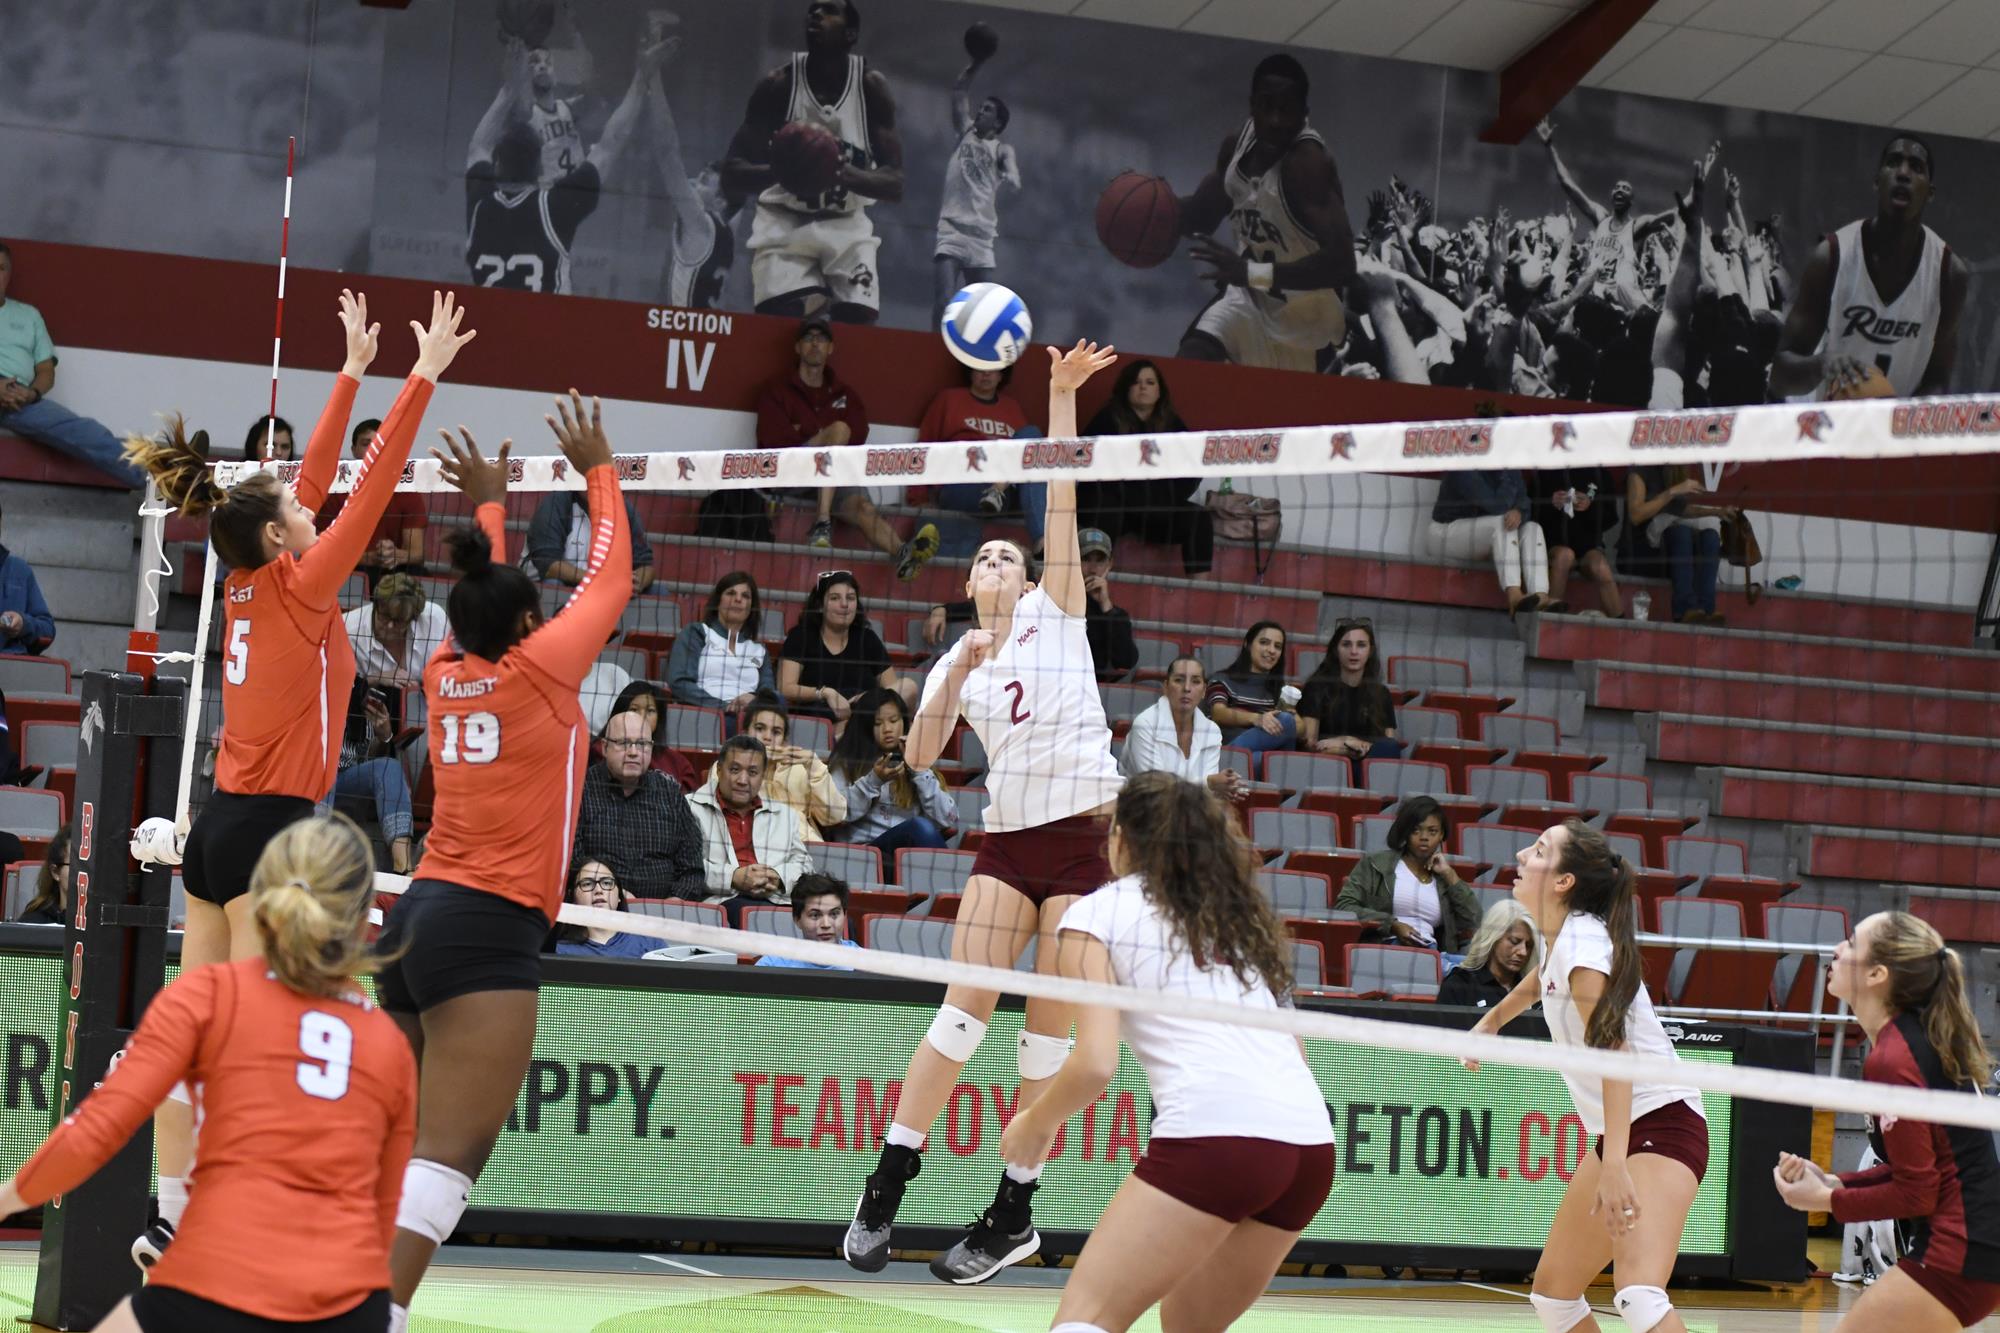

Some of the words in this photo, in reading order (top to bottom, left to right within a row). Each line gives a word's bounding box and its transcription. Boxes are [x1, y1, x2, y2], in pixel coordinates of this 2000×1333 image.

[475, 254, 543, 293] 23
[647, 308, 732, 335] SECTION
[1841, 305, 1922, 344] RIDER
[666, 338, 716, 391] IV
[1203, 434, 1283, 465] BRONCS
[1403, 424, 1494, 458] BRONCS
[1629, 414, 1735, 448] BRONCS
[722, 453, 779, 479] BRONCS
[865, 448, 929, 476] BRONCS
[1023, 442, 1095, 470] BRONCS
[226, 619, 251, 685] 5
[1004, 680, 1031, 726] 2
[441, 711, 500, 763] 19
[297, 1009, 353, 1100] 9
[1685, 1033, 1722, 1042] ANC
[7, 1034, 51, 1110] R
[507, 1059, 676, 1139] PPY.
